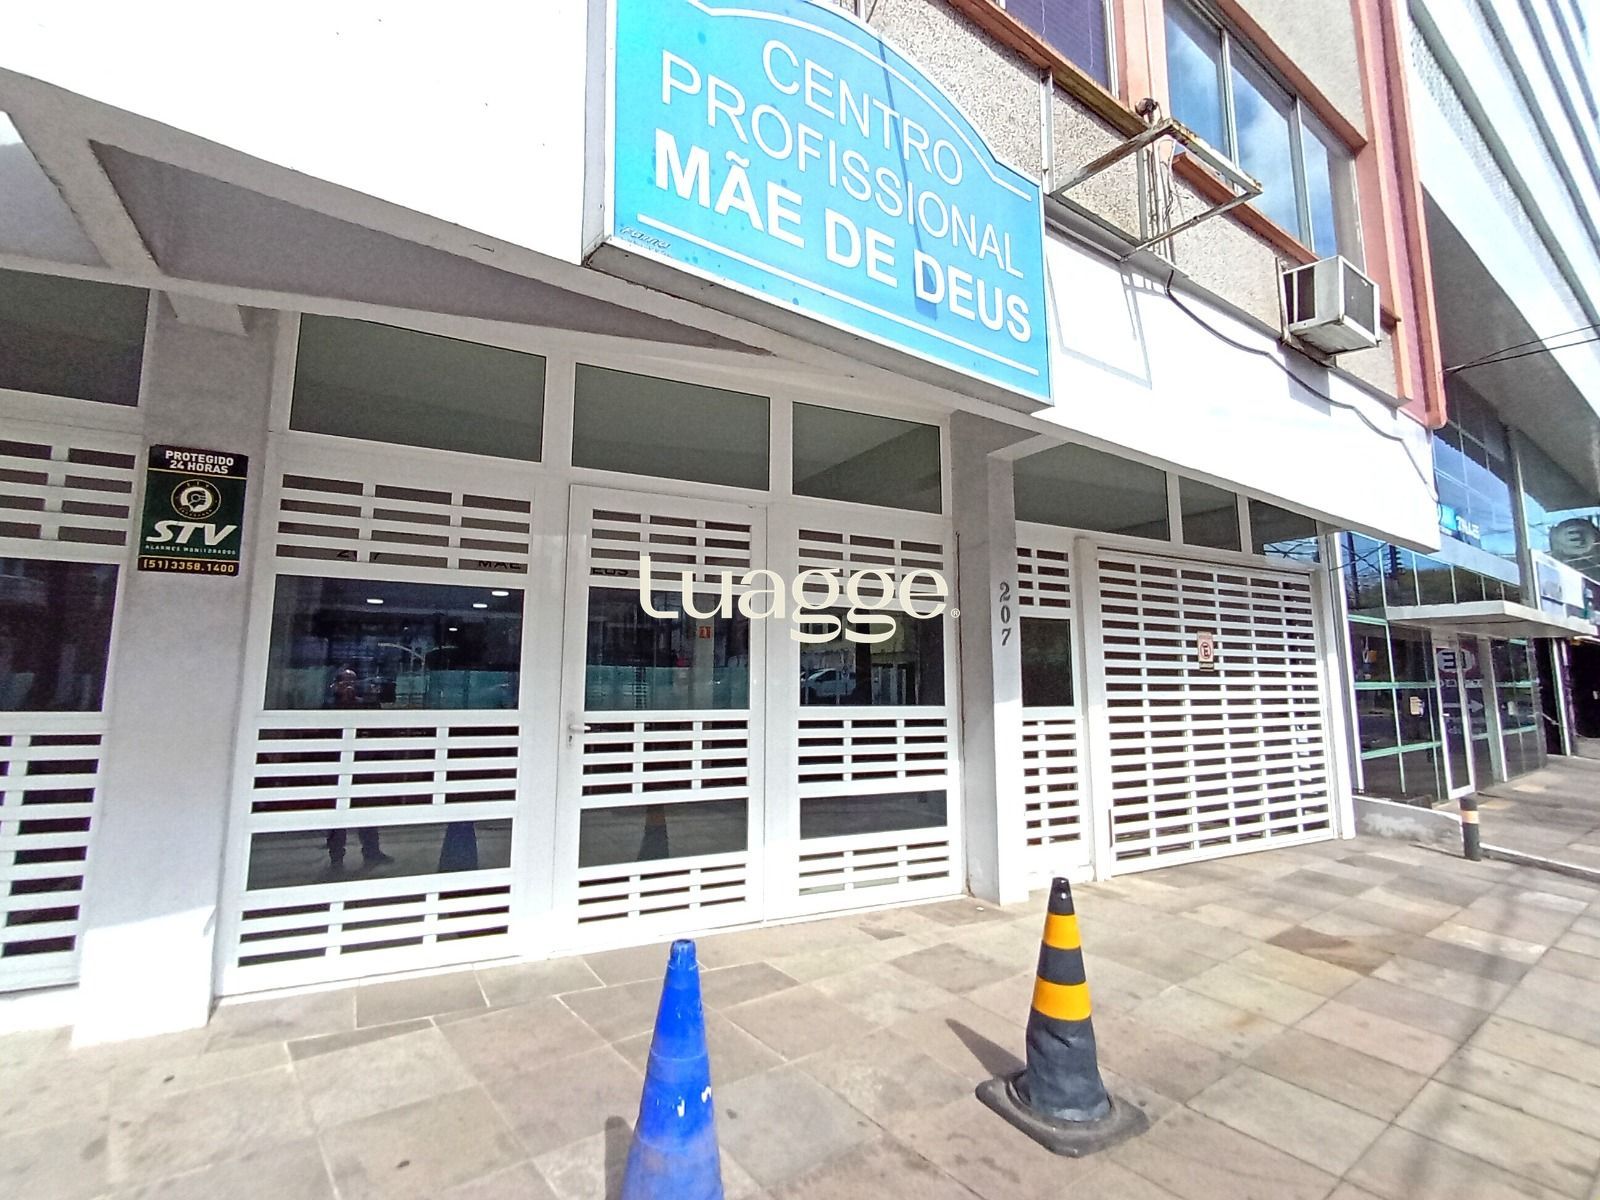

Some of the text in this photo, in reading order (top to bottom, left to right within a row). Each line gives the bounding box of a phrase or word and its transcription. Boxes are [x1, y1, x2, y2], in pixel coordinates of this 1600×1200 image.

[762, 39, 963, 186] CENTRO
[662, 49, 1024, 278] PROFISSIONAL
[655, 128, 1032, 343] MÃE DE DEUS
[165, 450, 234, 466] PROTEGIDO
[170, 460, 229, 475] 24 HORAS
[145, 520, 238, 546] STV
[143, 559, 235, 573] (51)3358.1400
[999, 581, 1012, 646] 207
